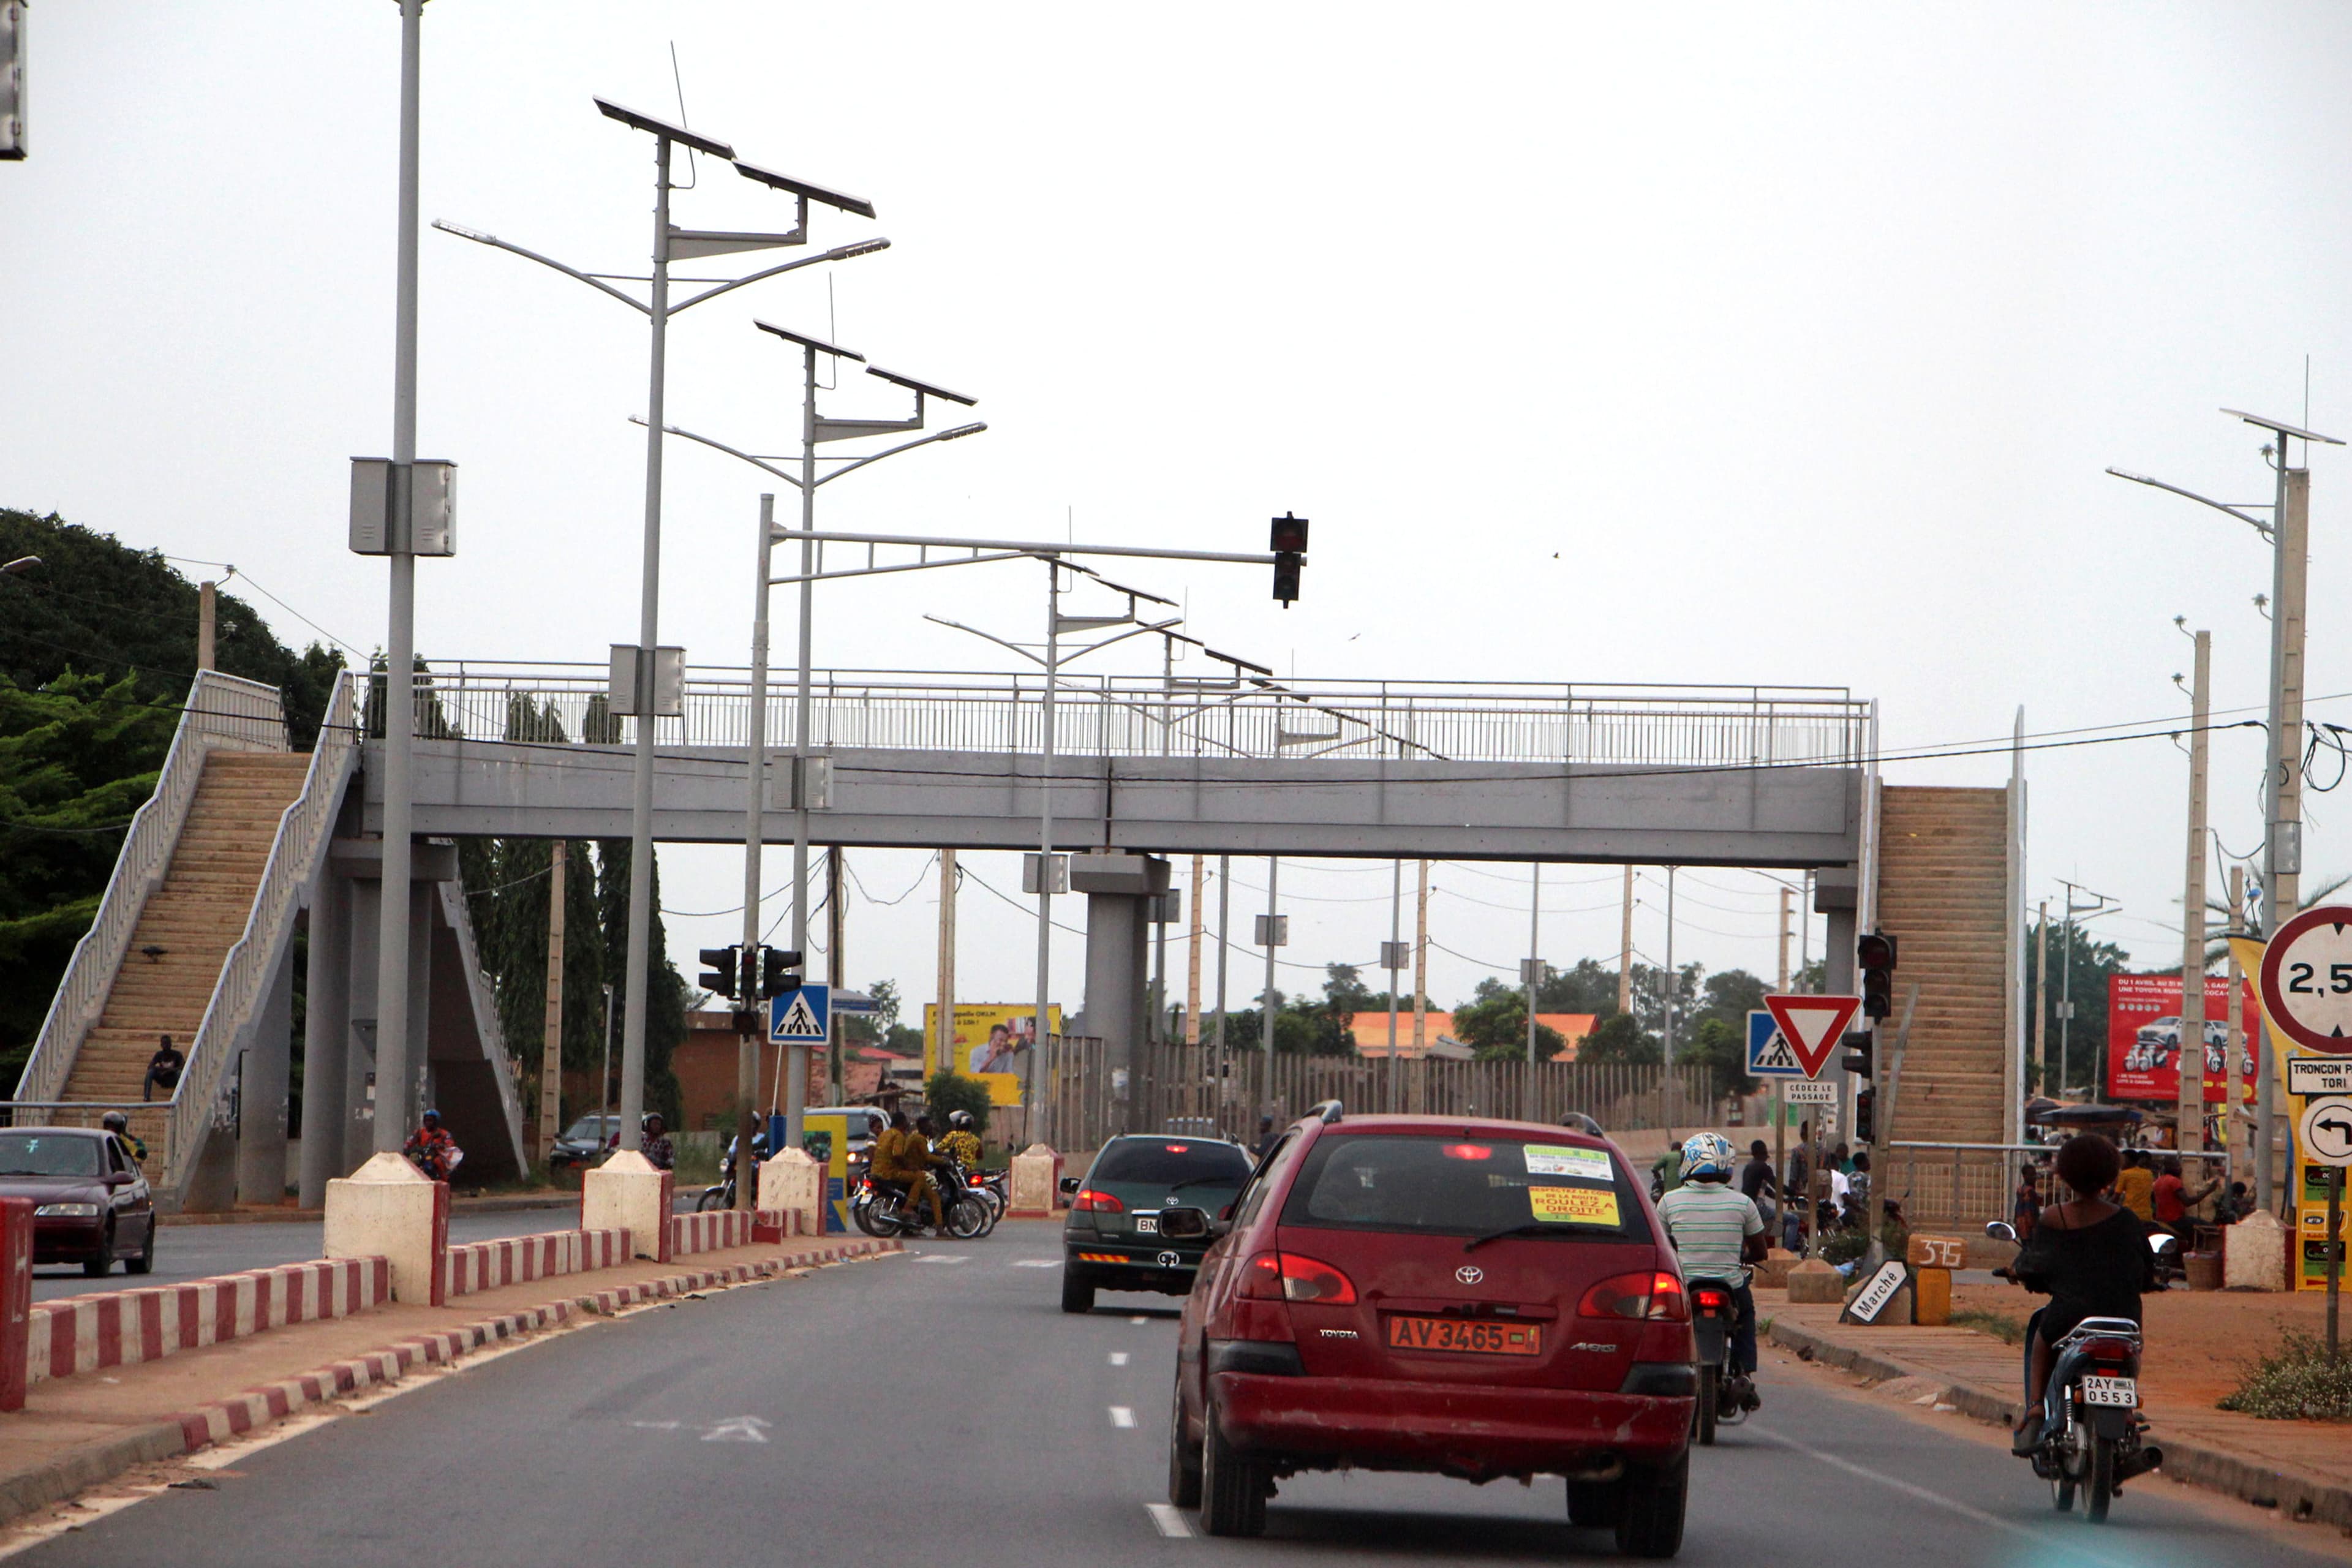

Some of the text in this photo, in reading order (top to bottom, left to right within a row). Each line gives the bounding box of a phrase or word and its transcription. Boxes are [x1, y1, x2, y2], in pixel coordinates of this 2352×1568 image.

[2294, 1065, 2341, 1074] TRONCON
[2322, 1078, 2346, 1088] TORI
[1536, 1198, 1600, 1207] ROULEZ
[1546, 1205, 1605, 1213] DROITE
[1918, 1239, 1962, 1267] 375
[1858, 1270, 1898, 1315] Marché
[1320, 1329, 1359, 1340] TOYOTA
[2087, 1378, 2111, 1390] 2AY
